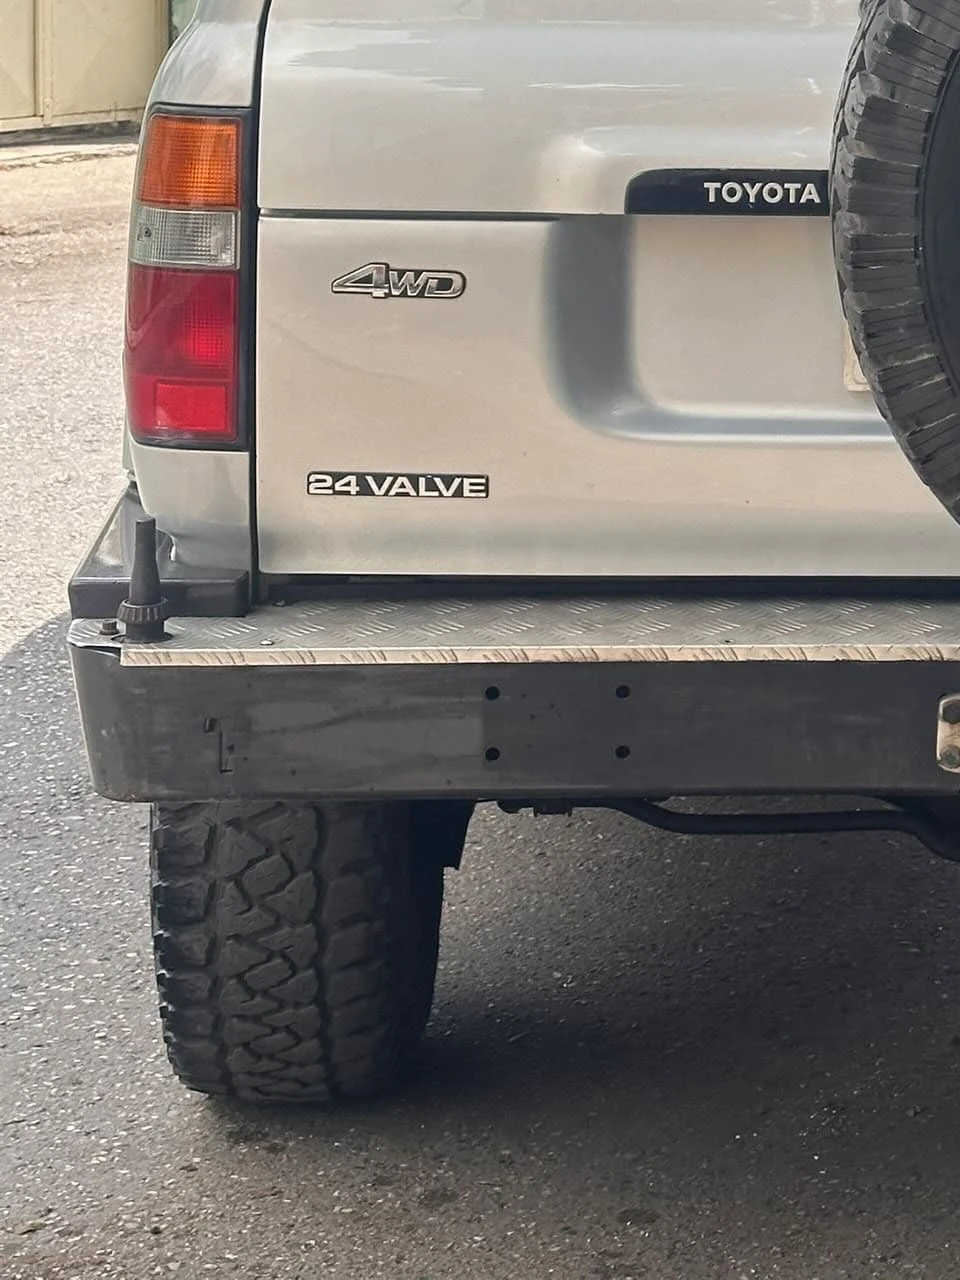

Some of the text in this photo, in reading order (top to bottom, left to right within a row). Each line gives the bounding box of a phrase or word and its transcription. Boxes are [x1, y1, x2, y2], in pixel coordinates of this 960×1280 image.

[703, 181, 821, 205] TOYOTA
[331, 262, 467, 300] 4WD
[307, 473, 488, 498] 24 VALVE
